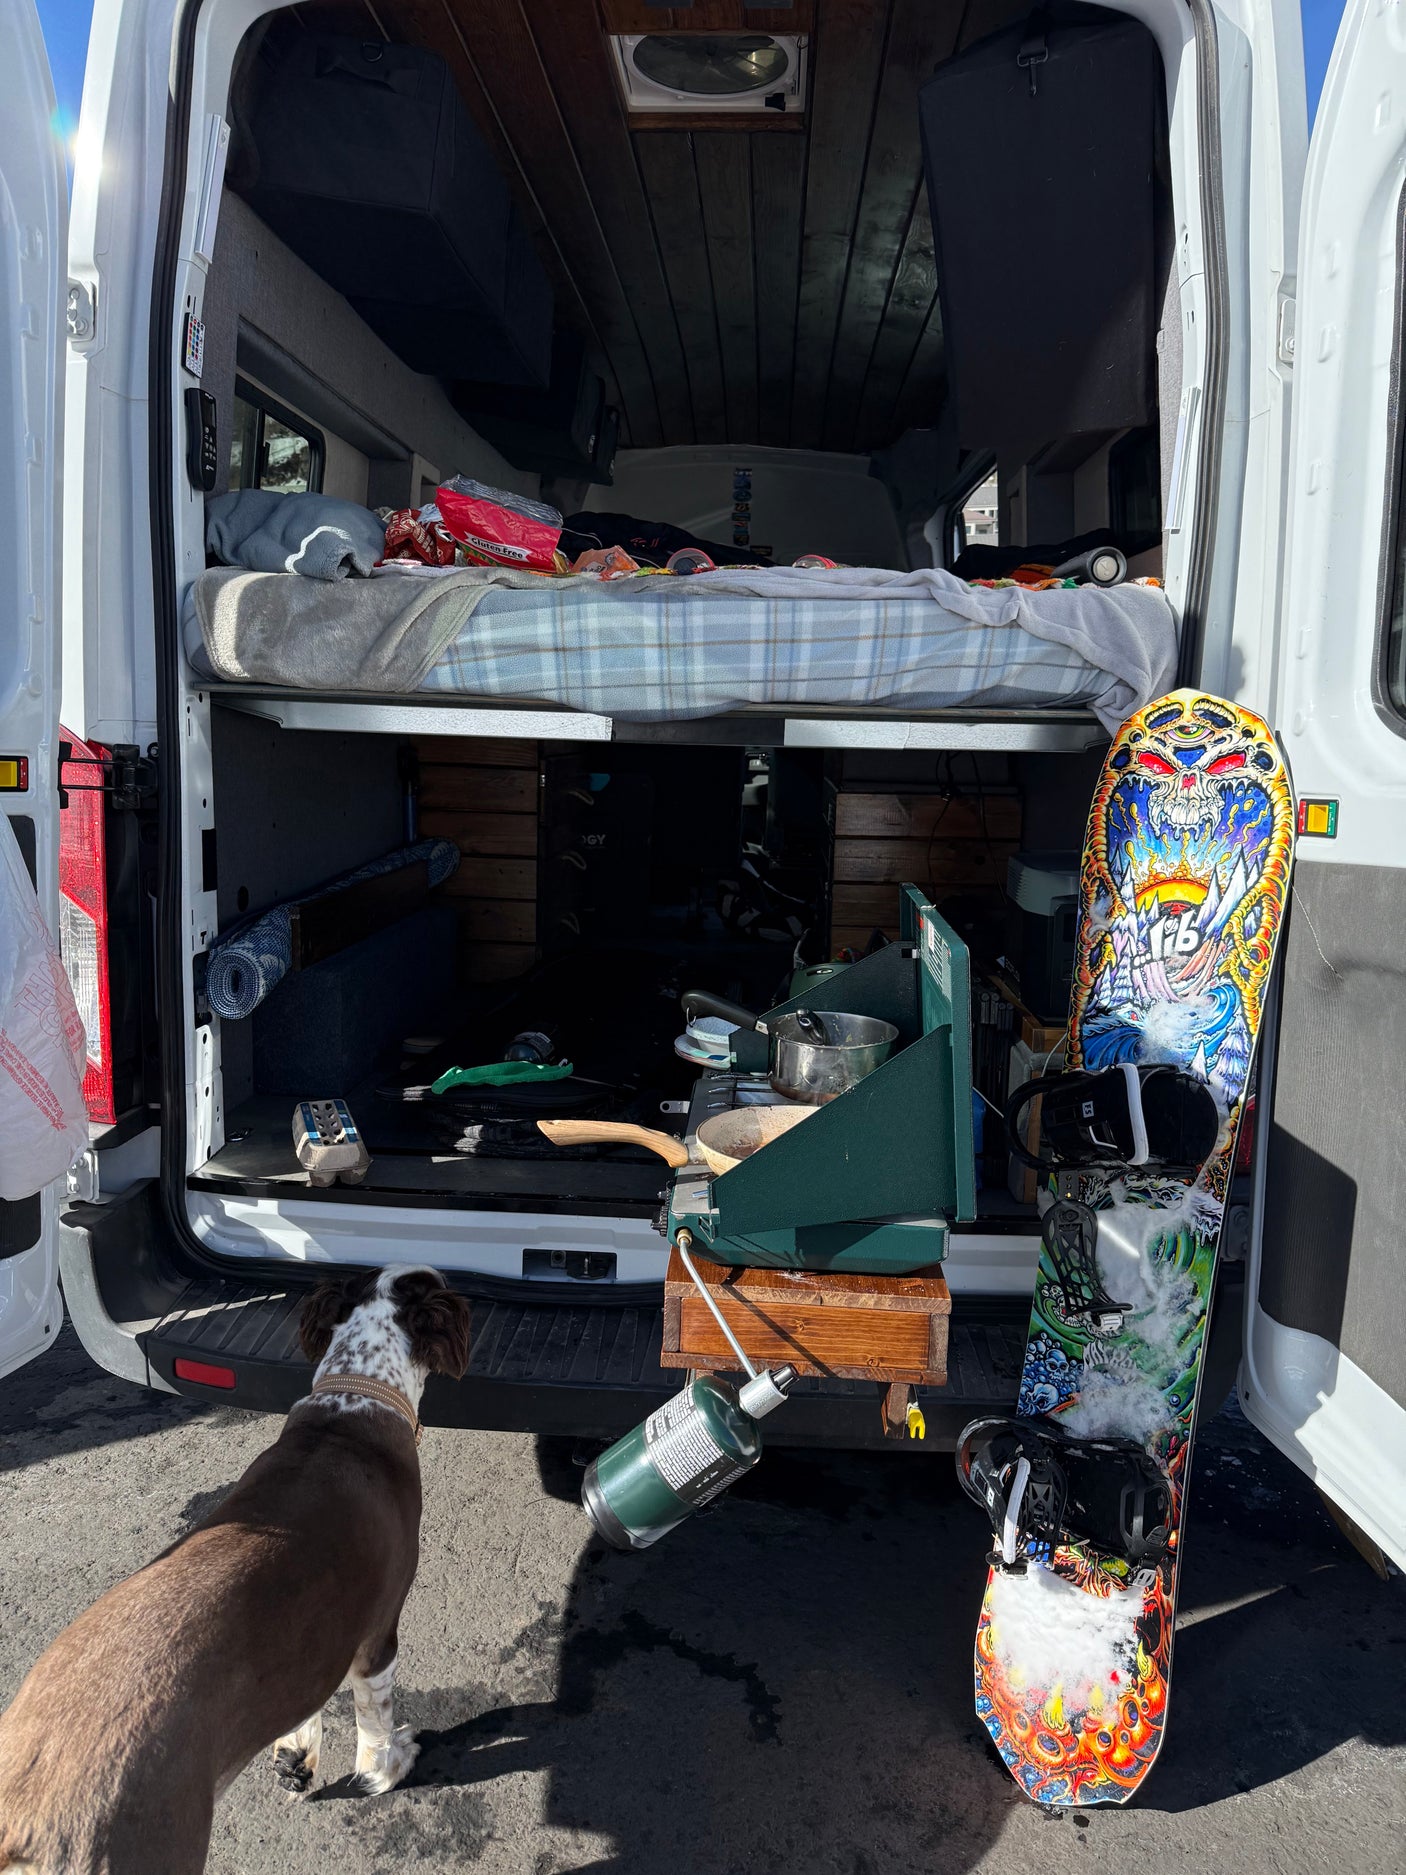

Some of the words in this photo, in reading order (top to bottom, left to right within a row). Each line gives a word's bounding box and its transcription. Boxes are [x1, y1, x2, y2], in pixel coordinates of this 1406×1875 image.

[471, 537, 501, 553] Gluten
[503, 547, 523, 559] Free
[1149, 909, 1199, 962] lib
